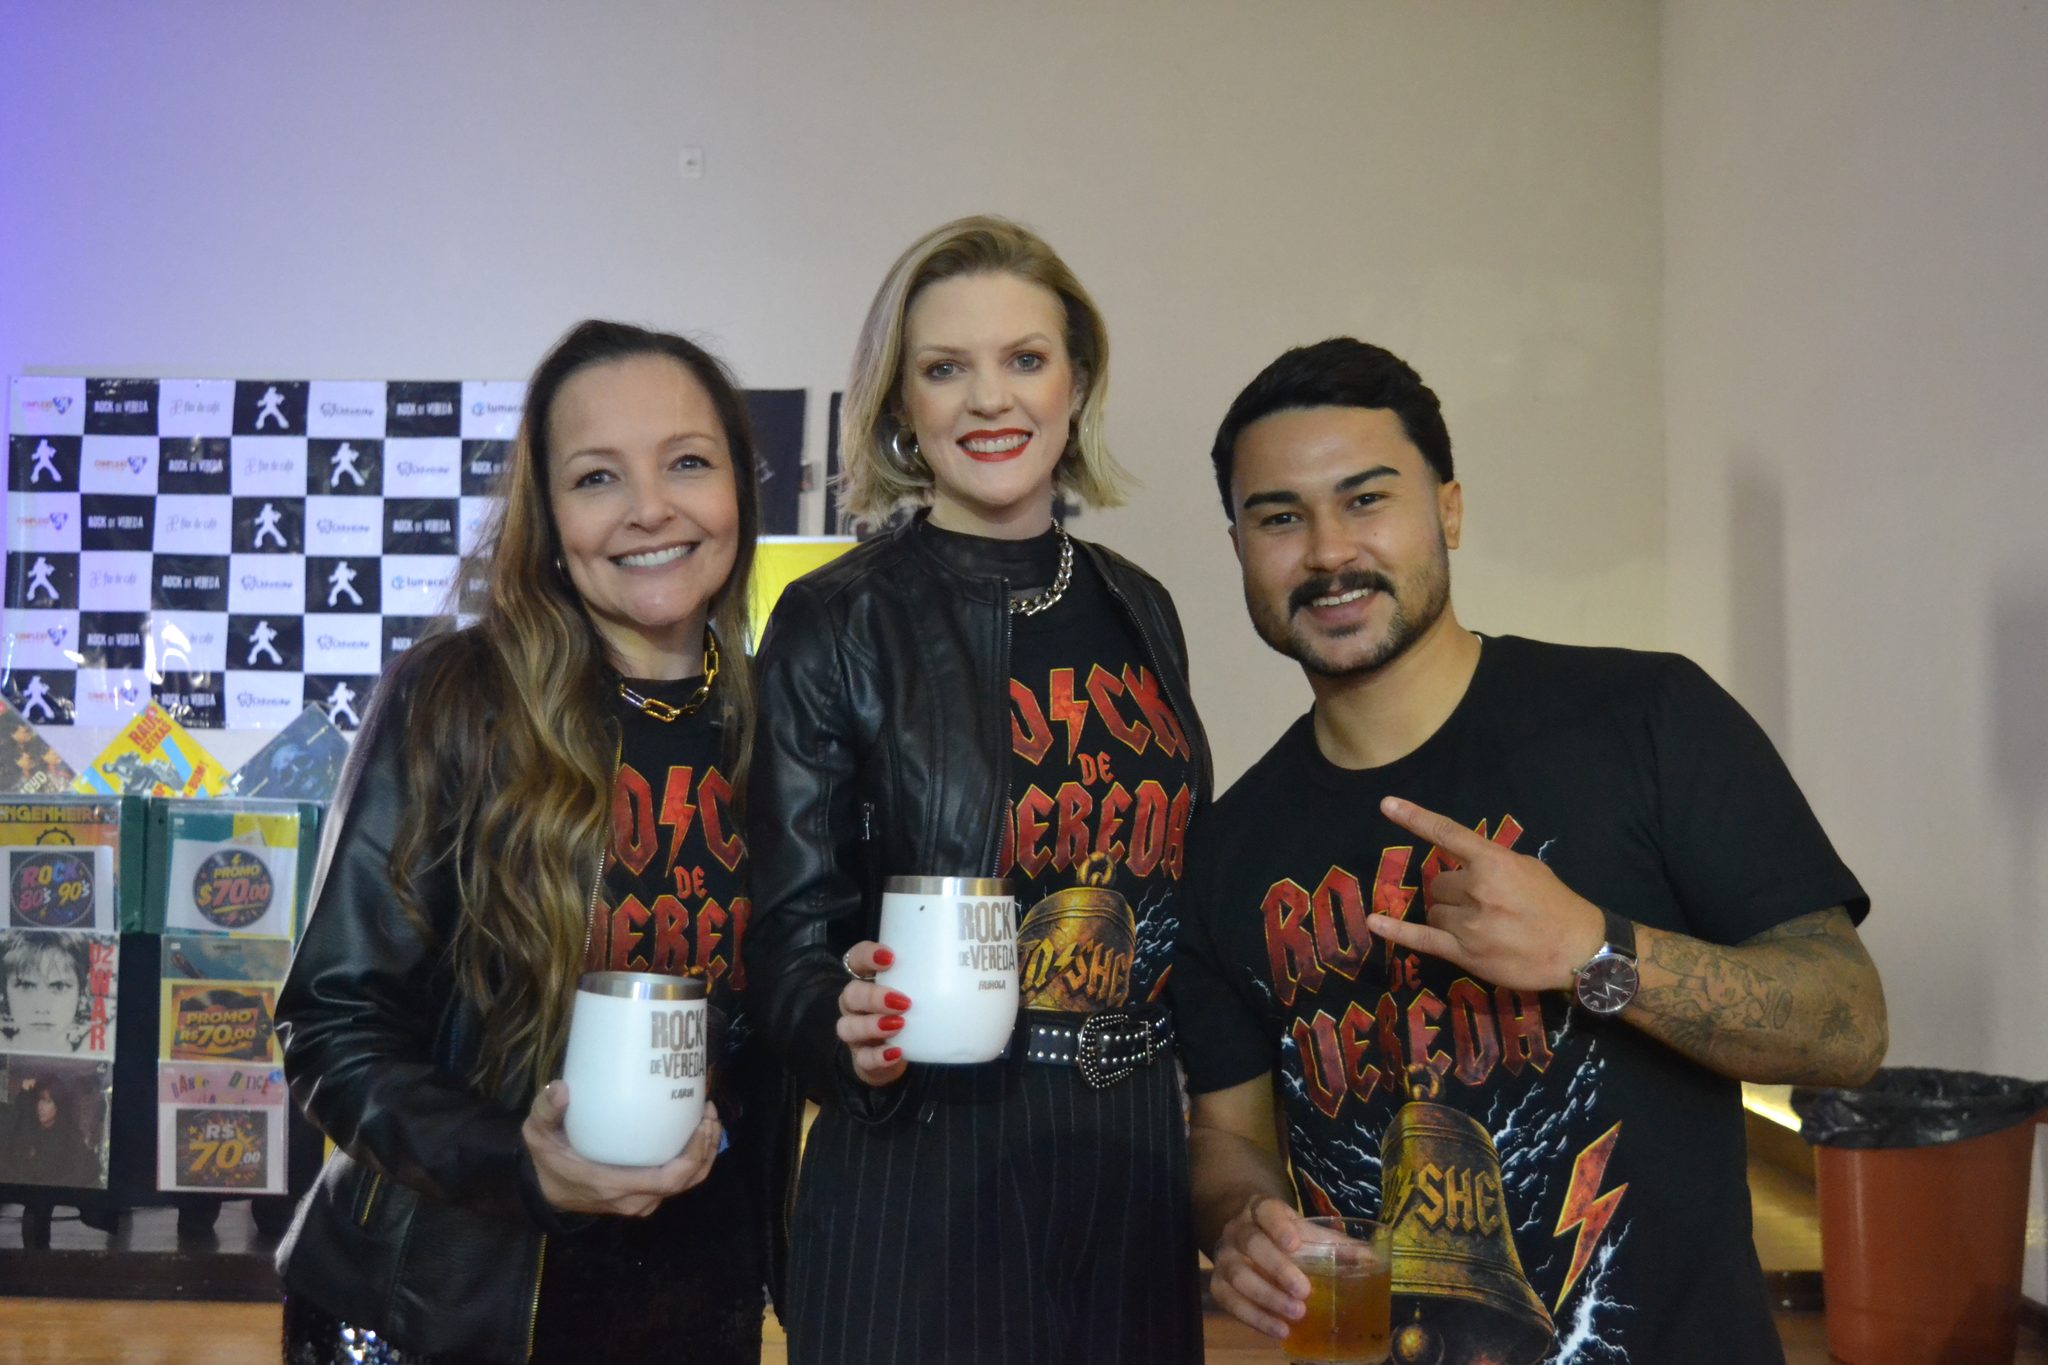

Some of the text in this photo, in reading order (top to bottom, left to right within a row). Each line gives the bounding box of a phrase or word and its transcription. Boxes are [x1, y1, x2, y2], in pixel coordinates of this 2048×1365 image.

[1077, 752, 1115, 785] DE
[21, 862, 78, 888] ROCK
[213, 864, 260, 879] PROMO
[674, 866, 708, 899] DE
[958, 901, 1012, 943] ROCK
[970, 944, 1016, 971] VEREDA
[187, 1009, 253, 1025] PROMO
[651, 1010, 704, 1051] ROCK
[662, 1053, 706, 1080] VEREDA
[206, 1120, 235, 1139] R$
